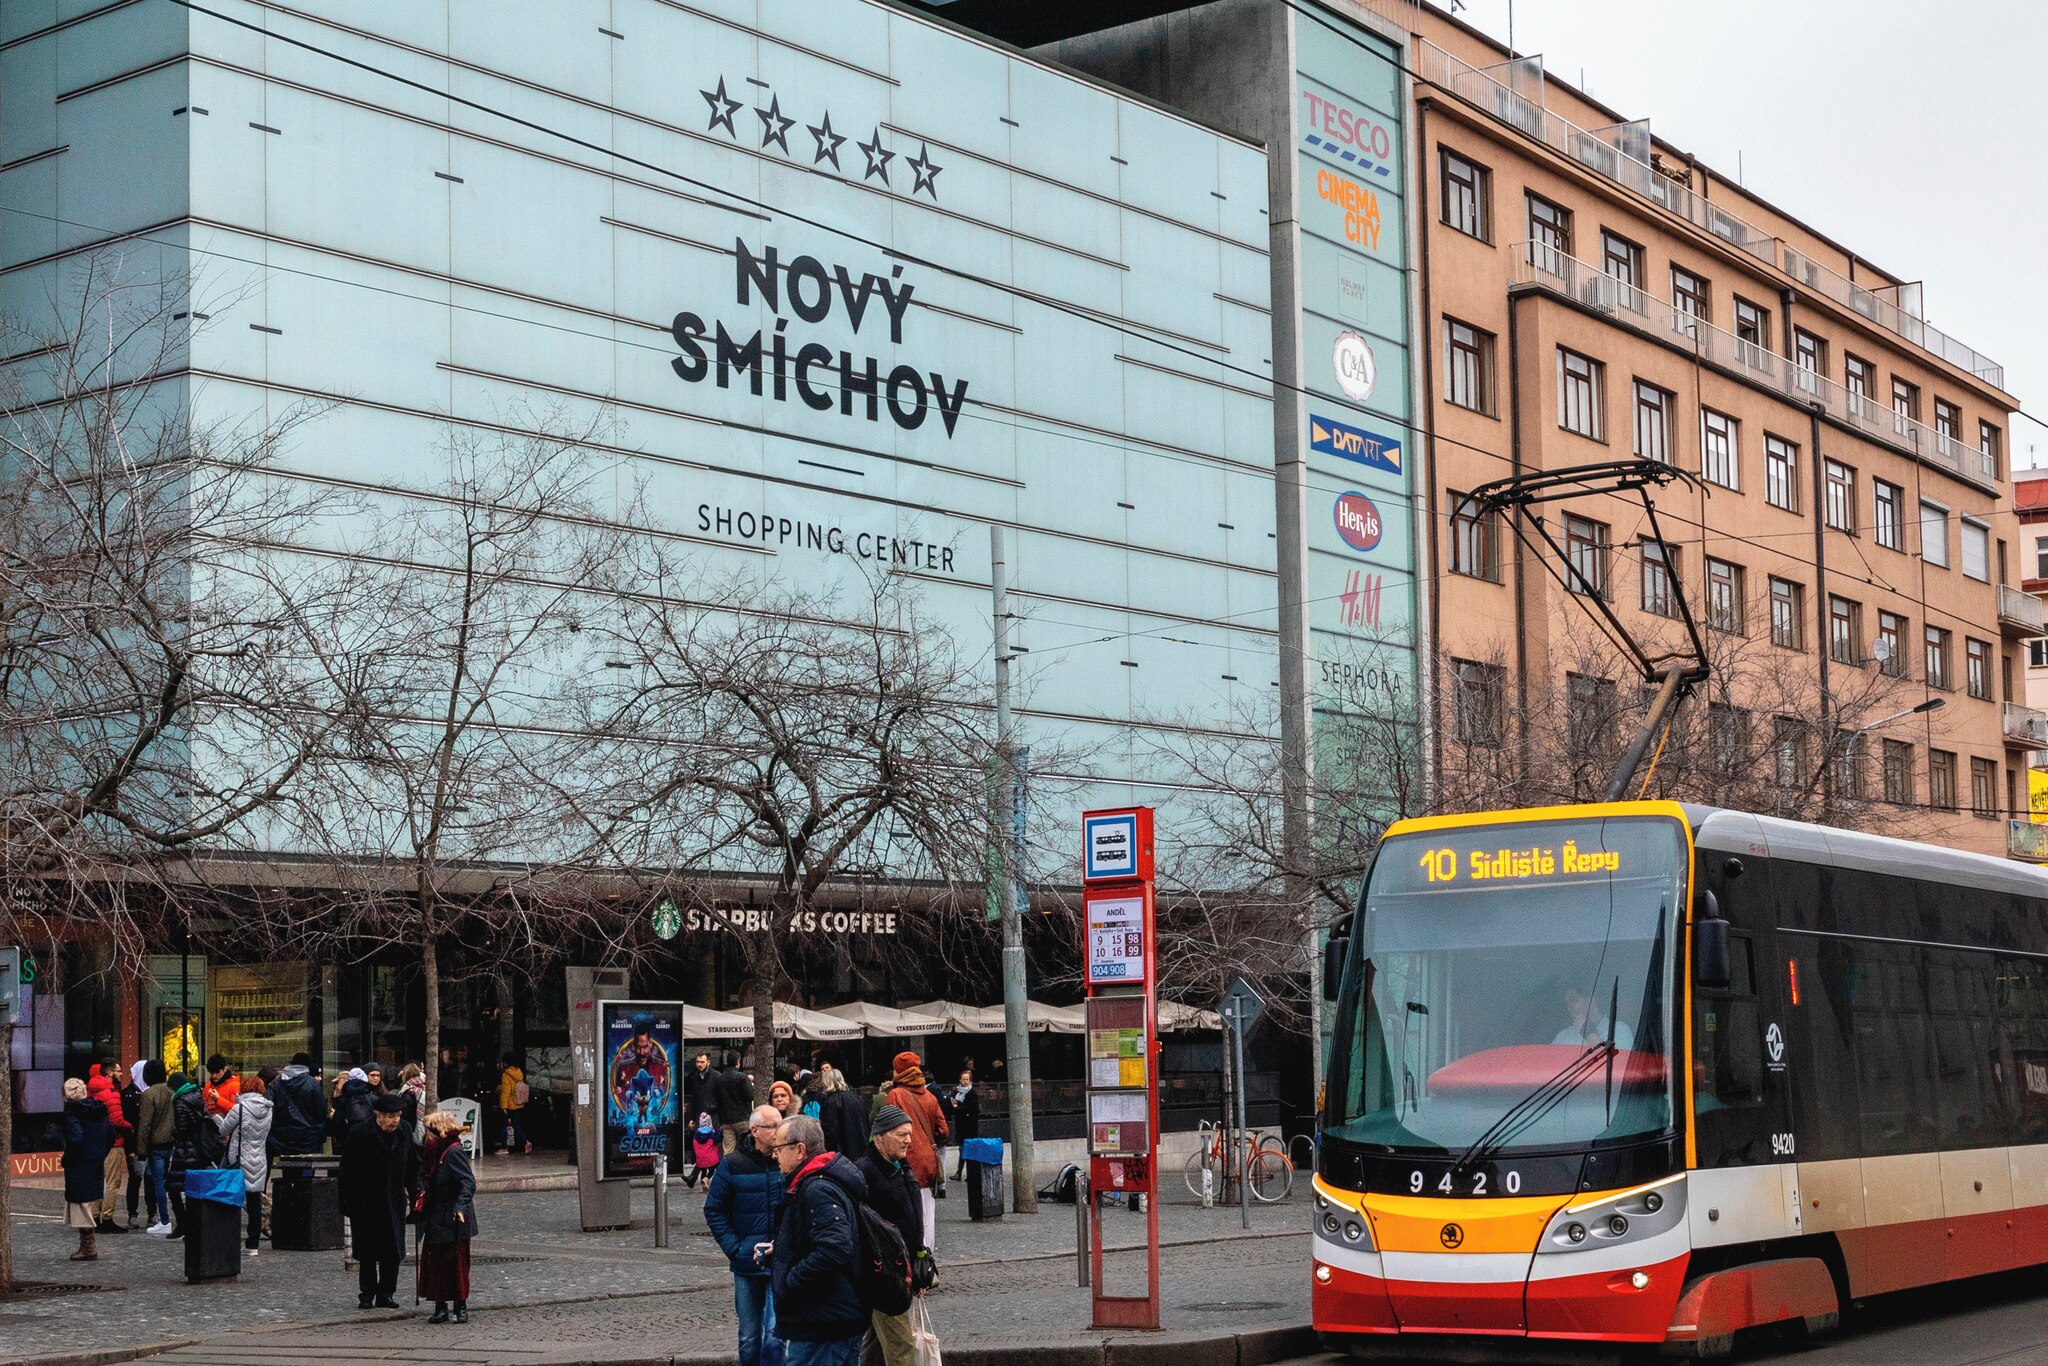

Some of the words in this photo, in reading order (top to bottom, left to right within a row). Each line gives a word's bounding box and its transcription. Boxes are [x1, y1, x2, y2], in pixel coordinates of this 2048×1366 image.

[1303, 91, 1390, 160] TESCO
[1317, 168, 1380, 223] CINEMA
[1345, 211, 1380, 251] CITY
[736, 236, 915, 344] NOVÝ
[671, 311, 969, 440] SMÍCHOV
[1340, 347, 1370, 385] C&A
[1333, 428, 1383, 462] DATART
[1339, 500, 1379, 539] Hervis
[698, 503, 844, 554] SHOPPING
[856, 532, 954, 573] CENTER
[1339, 568, 1382, 632] H&M
[1321, 660, 1402, 694] SEPHORA
[1420, 848, 1457, 882] 10
[1469, 847, 1555, 880] Sídliště
[1562, 840, 1620, 874] Řepy
[820, 911, 897, 934] COFFEE
[1097, 935, 1103, 945] 9
[1111, 934, 1122, 945] 15
[1127, 933, 1139, 944] 98
[1096, 947, 1106, 958] 10
[1112, 946, 1123, 957] 16
[1128, 945, 1140, 956] 99
[1093, 965, 1109, 976] 904
[1110, 964, 1126, 975] 908
[619, 1135, 667, 1153] SONIC
[1772, 1133, 1795, 1155] 9420
[14, 1153, 65, 1174] VŮNĚ
[1409, 1170, 1521, 1195] 9420
